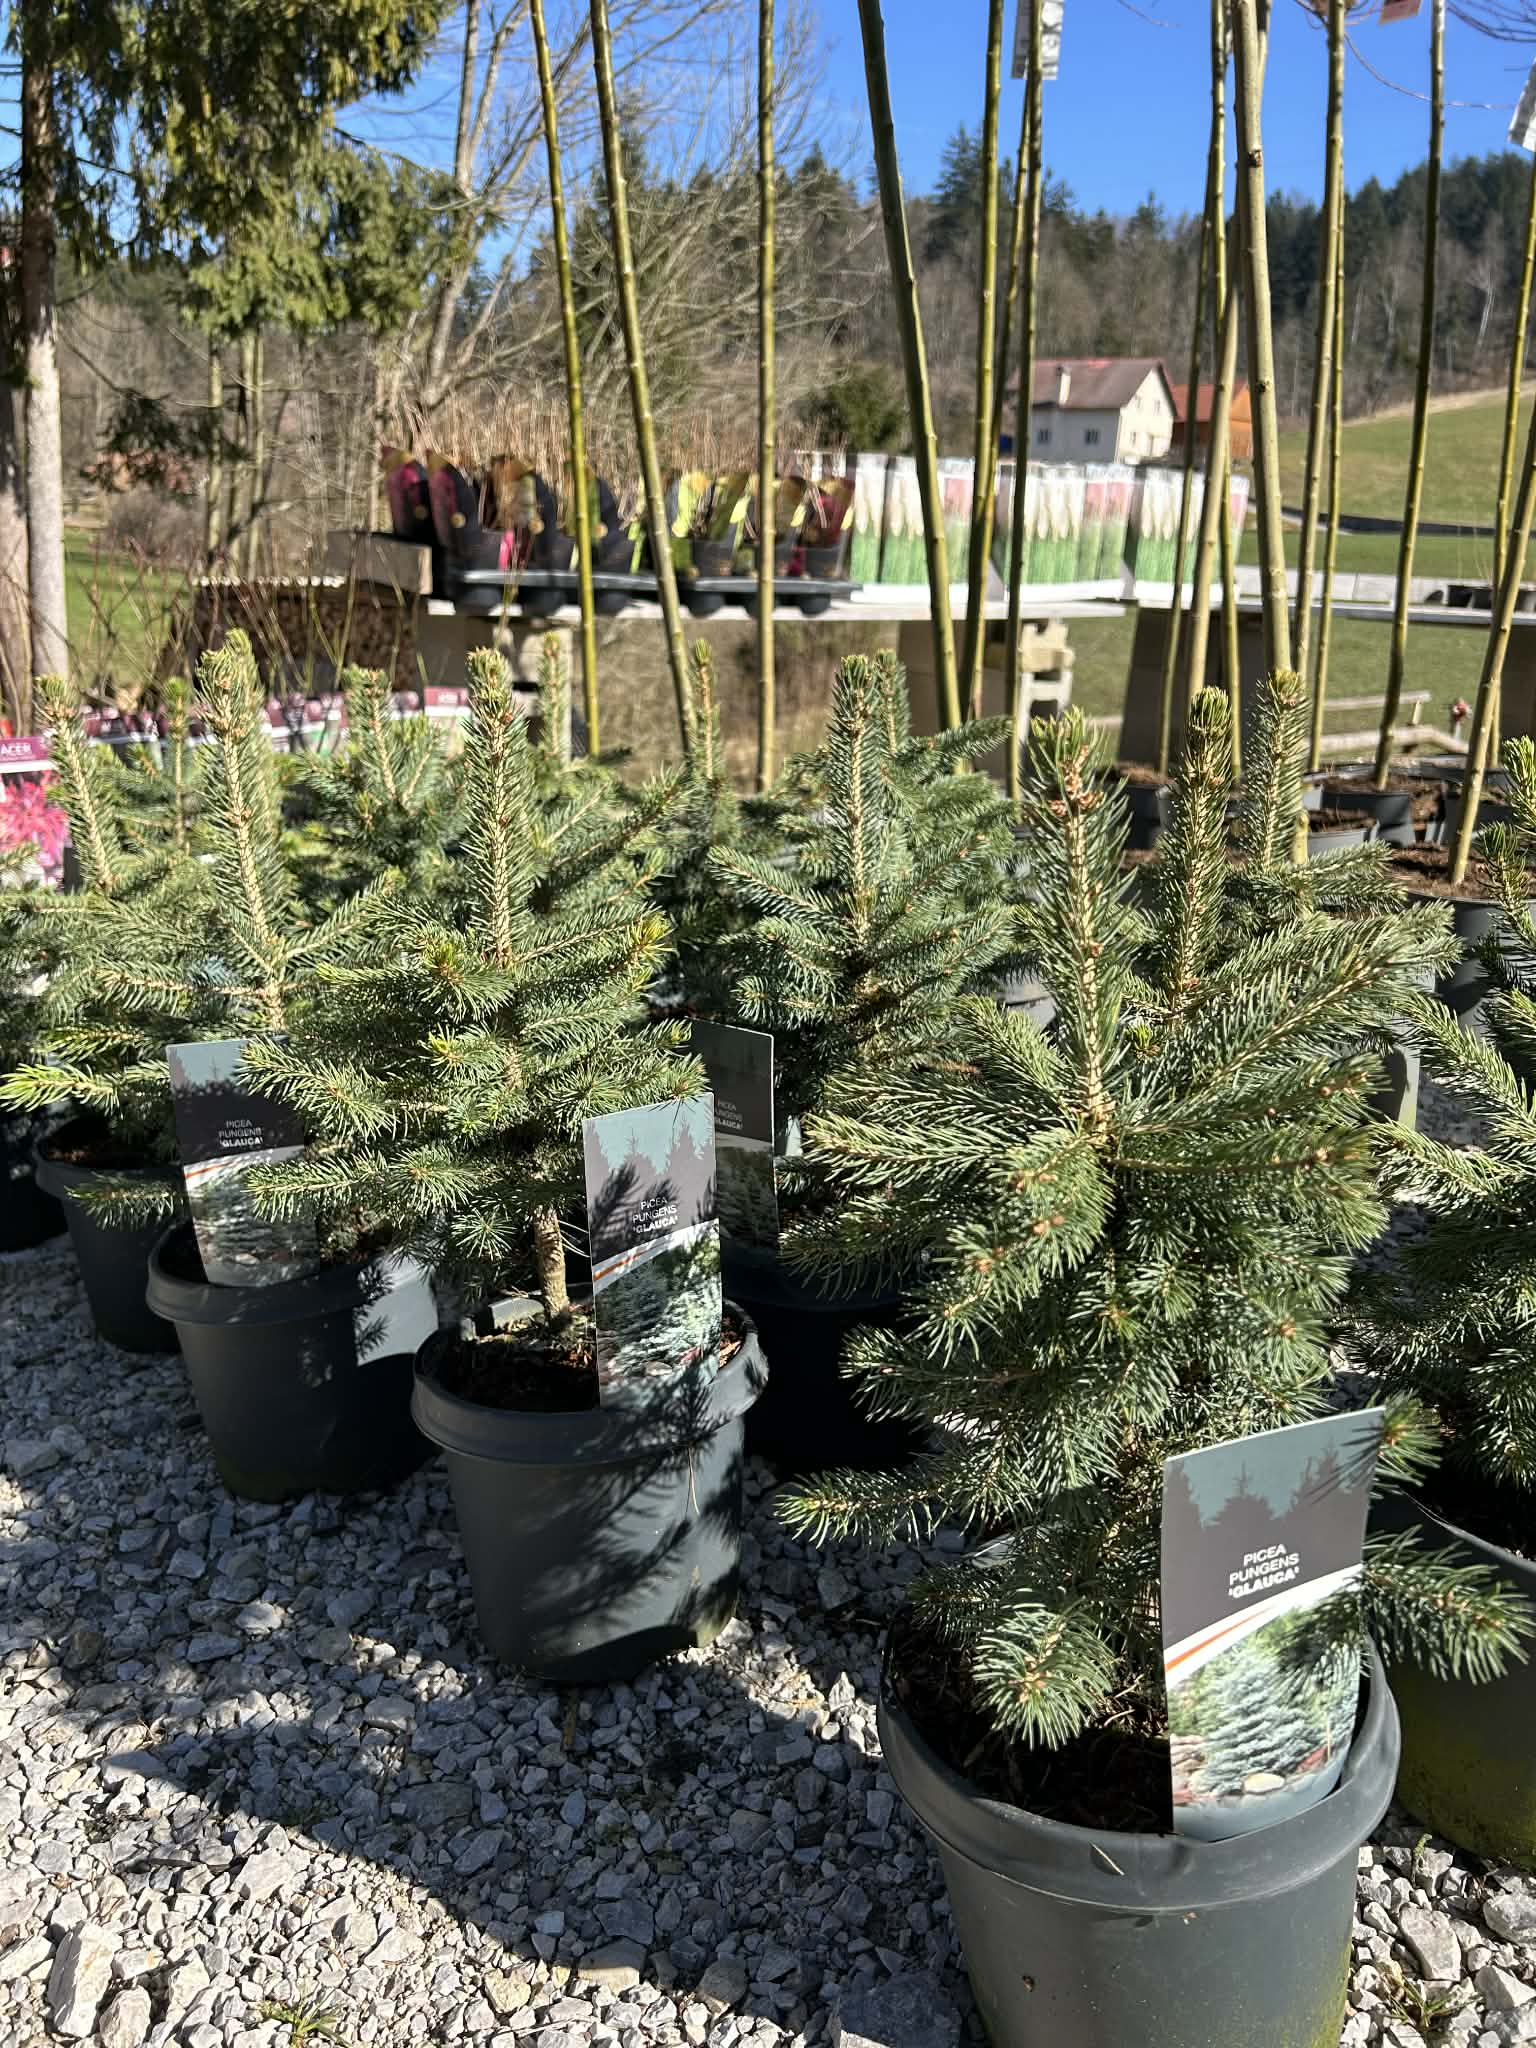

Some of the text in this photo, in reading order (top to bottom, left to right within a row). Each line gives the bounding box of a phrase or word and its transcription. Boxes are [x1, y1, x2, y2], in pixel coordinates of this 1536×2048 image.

[219, 1127, 262, 1138] PUNGENS
[226, 1119, 252, 1128] PICEA
[641, 1196, 668, 1210] PICEA
[632, 1204, 678, 1223] PUNGENS
[633, 1215, 678, 1234] 'GLAUCA'
[1243, 1543, 1287, 1567] PICEA
[1229, 1552, 1300, 1586] PUNGENS
[1228, 1566, 1300, 1599] 'GLAUCA'
